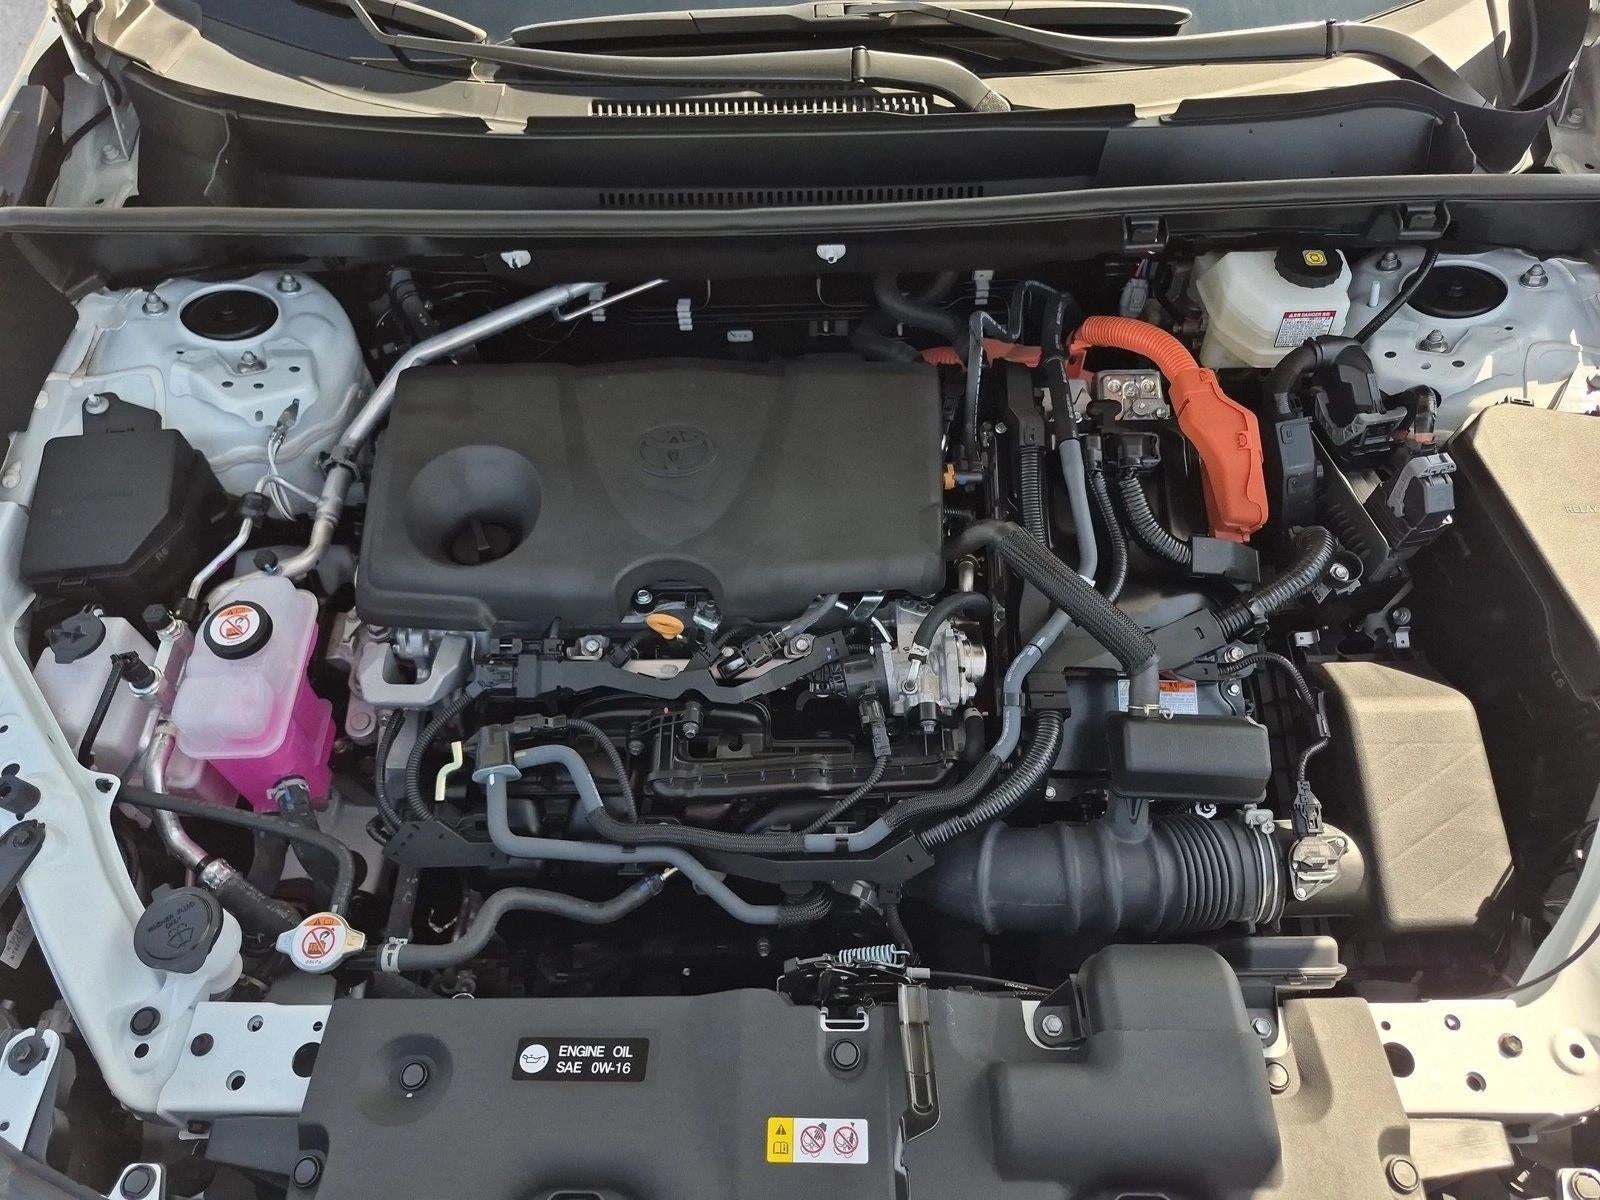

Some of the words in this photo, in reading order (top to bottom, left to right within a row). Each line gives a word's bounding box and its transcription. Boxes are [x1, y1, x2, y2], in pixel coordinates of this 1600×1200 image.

[1564, 505, 1598, 514] RELAY
[558, 1045, 605, 1057] ENGINE
[613, 1045, 633, 1058] OIL
[556, 1061, 582, 1074] SAE
[591, 1062, 631, 1074] 0W-16
